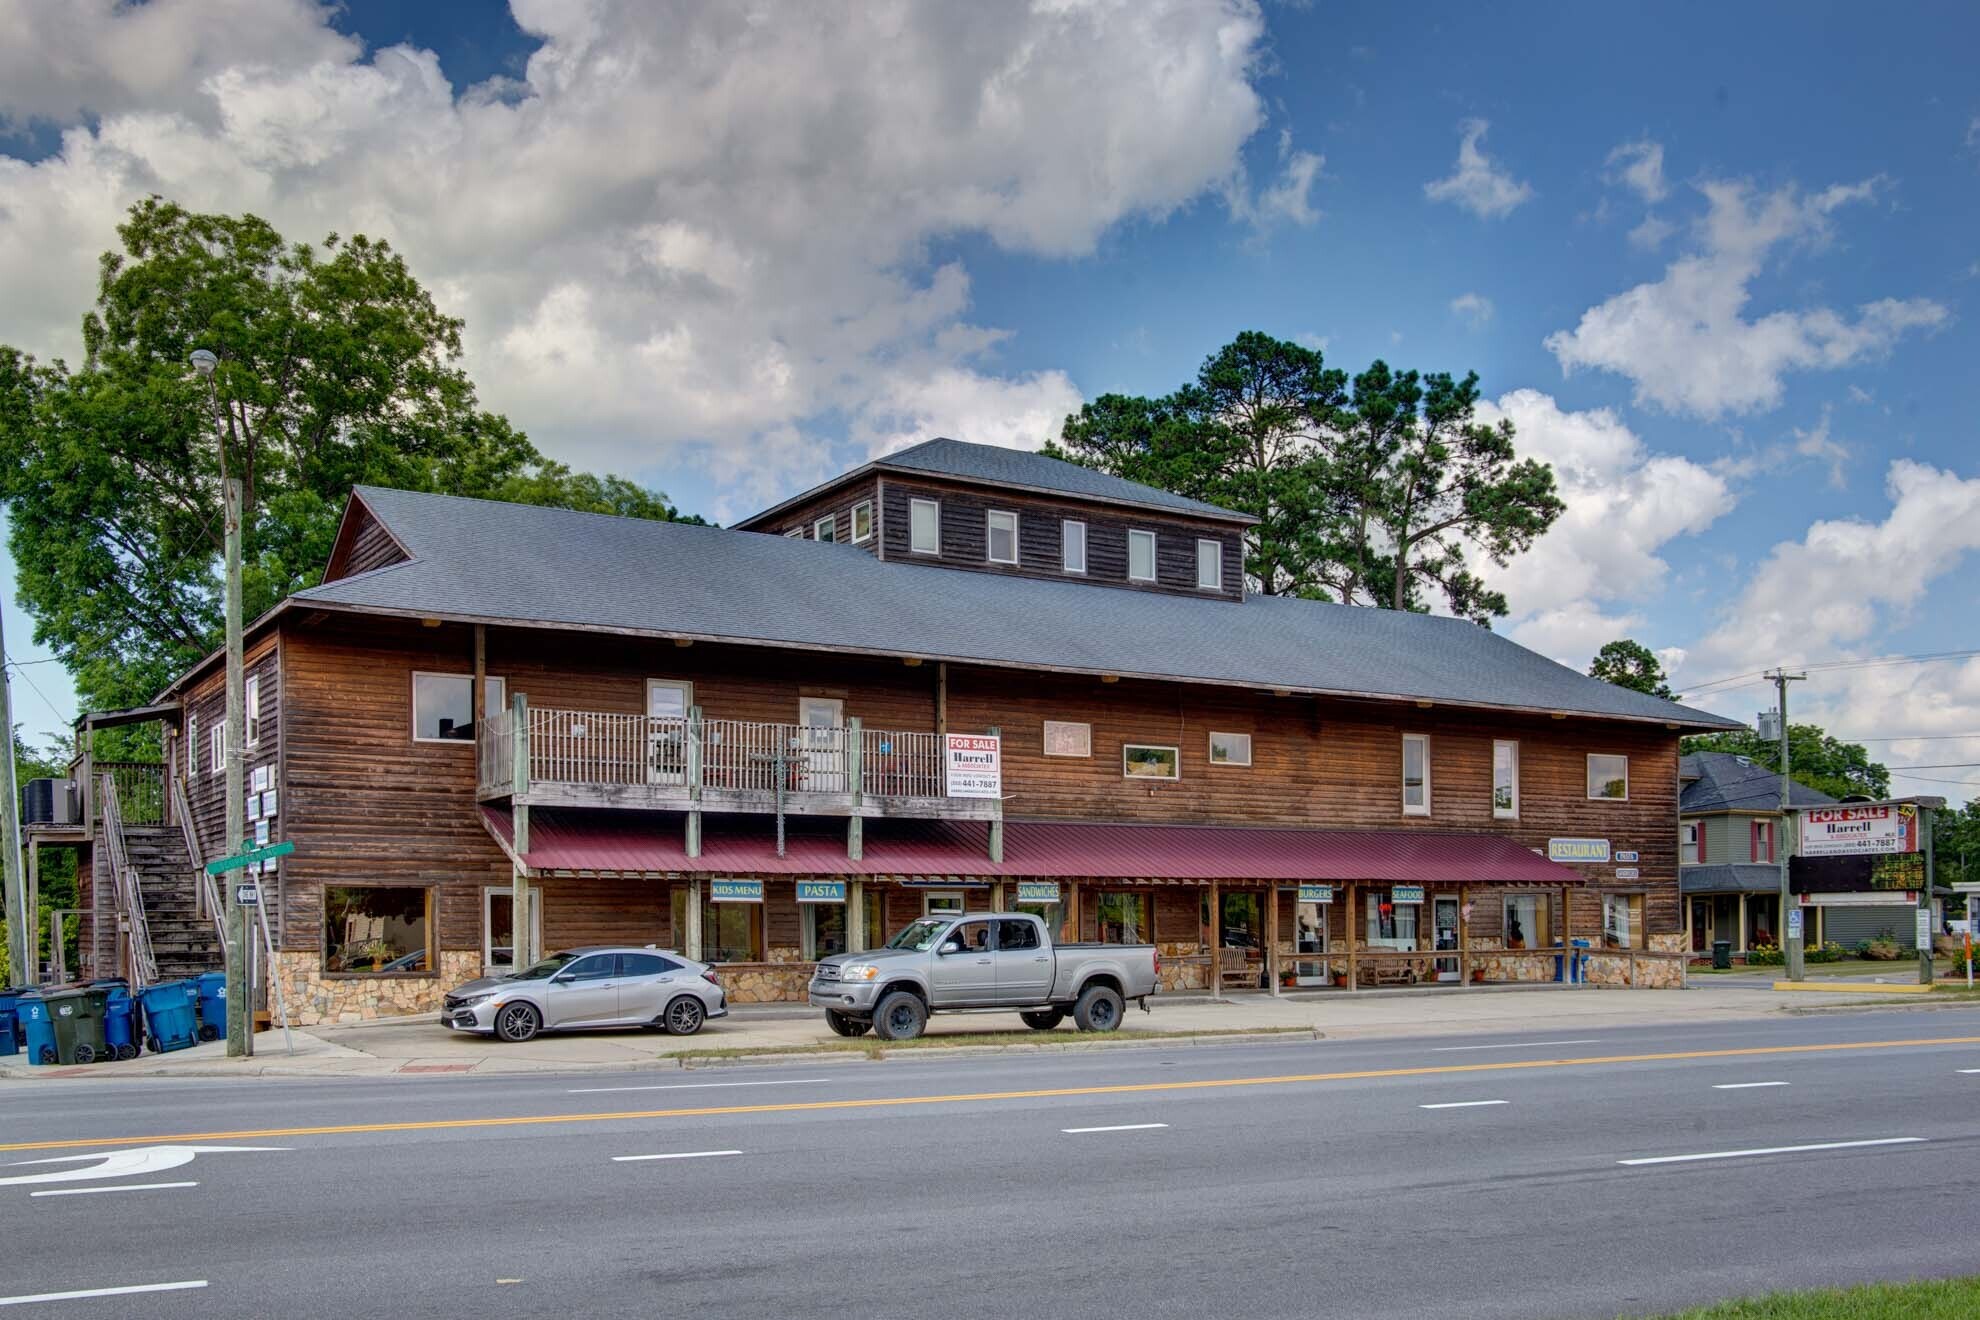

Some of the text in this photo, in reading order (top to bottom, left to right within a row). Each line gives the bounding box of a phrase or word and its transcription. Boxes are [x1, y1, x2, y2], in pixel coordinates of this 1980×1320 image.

[950, 738, 996, 750] FOR SALE
[953, 752, 993, 763] Harrell
[962, 780, 997, 789] 441-7887
[1812, 806, 1886, 821] FOR SALE
[1826, 821, 1871, 834] Harrell
[1857, 838, 1896, 847] 441-7887
[1551, 843, 1608, 858] RESTAURANT
[713, 885, 761, 896] KIDS MENU
[804, 885, 838, 897] PASTA
[1017, 885, 1059, 898] SANDWICHES
[1299, 887, 1333, 899] BURGERS
[1392, 888, 1424, 899] SEAFOOD
